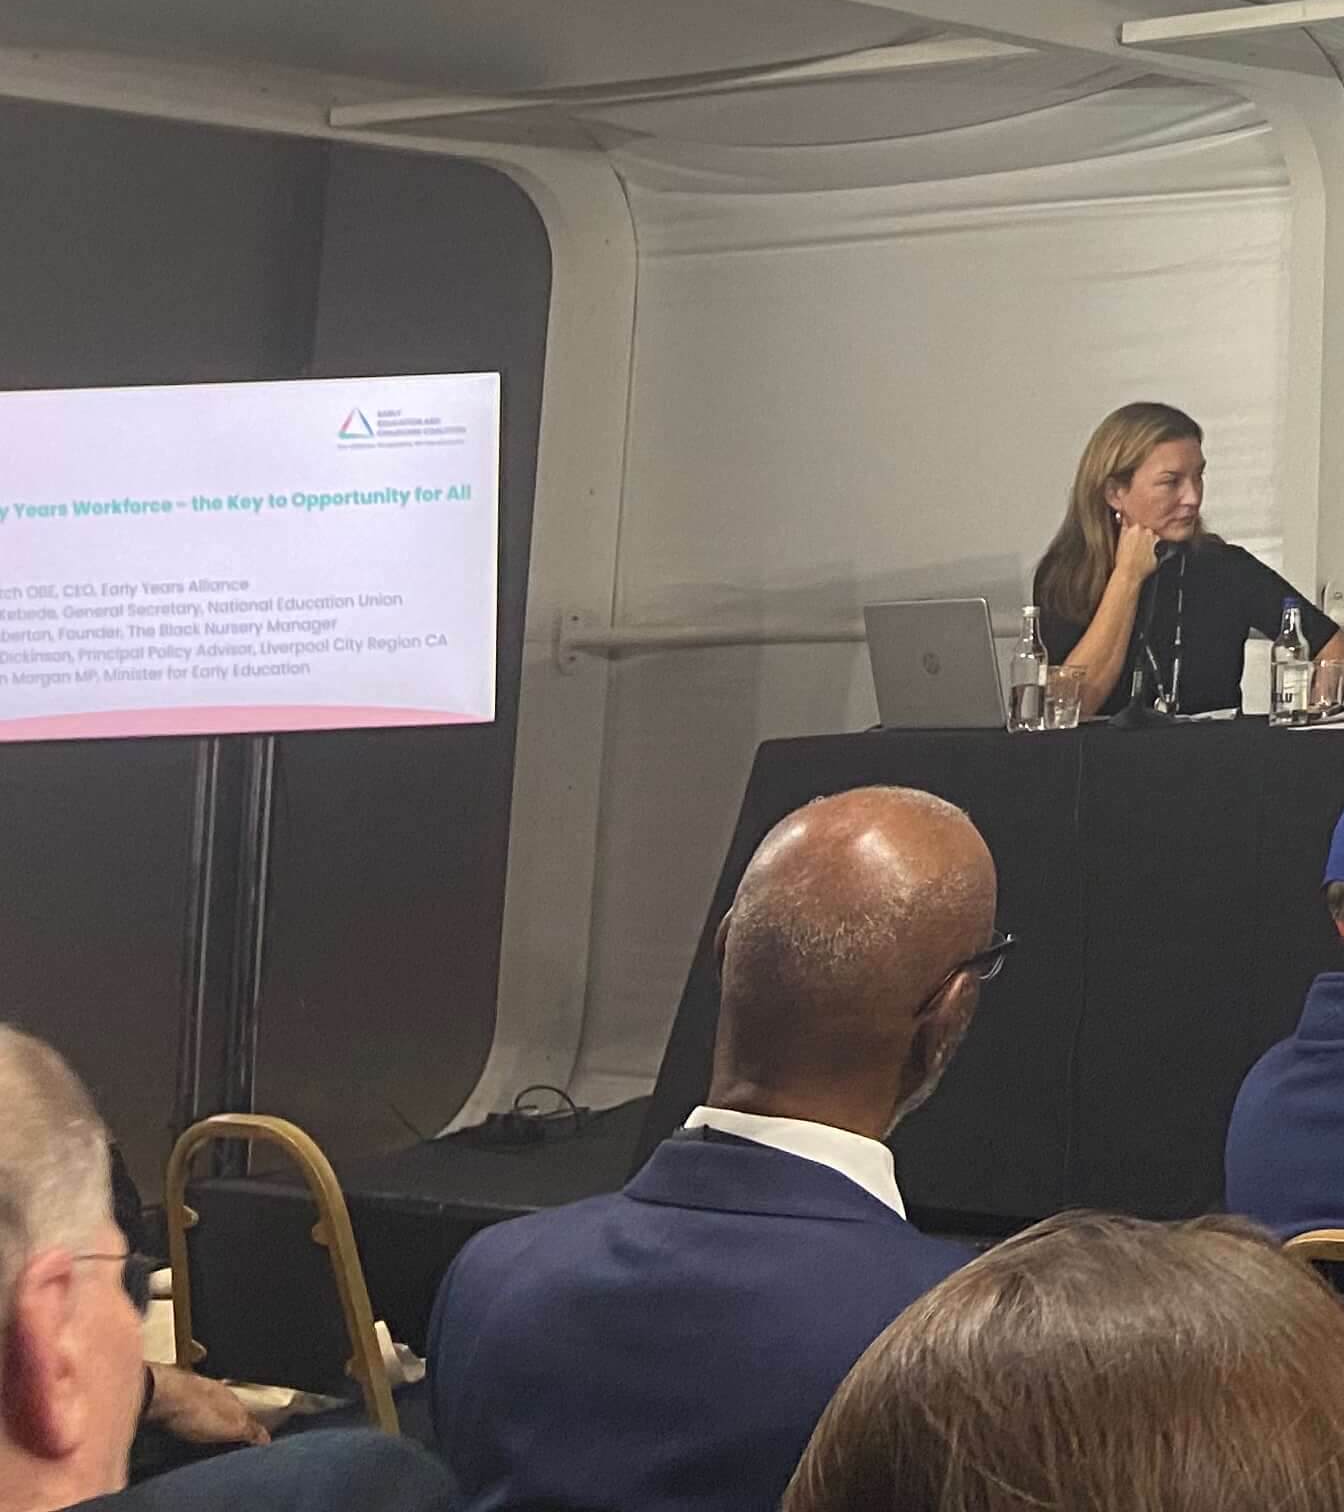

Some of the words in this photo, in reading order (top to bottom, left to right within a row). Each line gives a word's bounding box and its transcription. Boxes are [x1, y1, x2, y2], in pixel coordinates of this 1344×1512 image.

[13, 502, 68, 519] Years
[72, 498, 173, 517] Workforce
[192, 494, 223, 511] the
[227, 494, 264, 514] Key
[268, 493, 287, 509] to
[292, 487, 410, 512] Opportunity
[414, 486, 443, 502] for
[446, 485, 472, 500] All
[101, 582, 138, 599] Early
[142, 580, 184, 595] Years
[188, 578, 250, 593] Alliance
[63, 603, 124, 619] General
[127, 601, 205, 617] Secretary,
[207, 597, 273, 614] National
[277, 594, 354, 612] Education
[358, 592, 404, 608] Union
[128, 624, 156, 638] The
[159, 622, 201, 637] Black
[204, 619, 263, 636] Nursery
[267, 618, 338, 635] Manager
[78, 646, 144, 664] Principal
[148, 644, 192, 660] Policy
[196, 641, 257, 657] Advisor,
[260, 638, 329, 657] Liverpool
[333, 636, 364, 653] City
[367, 635, 421, 653] Region
[425, 633, 448, 648] CA
[11, 671, 71, 688] Morgan
[103, 666, 163, 682] Minister
[167, 665, 188, 680] for
[191, 663, 228, 680] Early
[233, 661, 311, 679] Education
